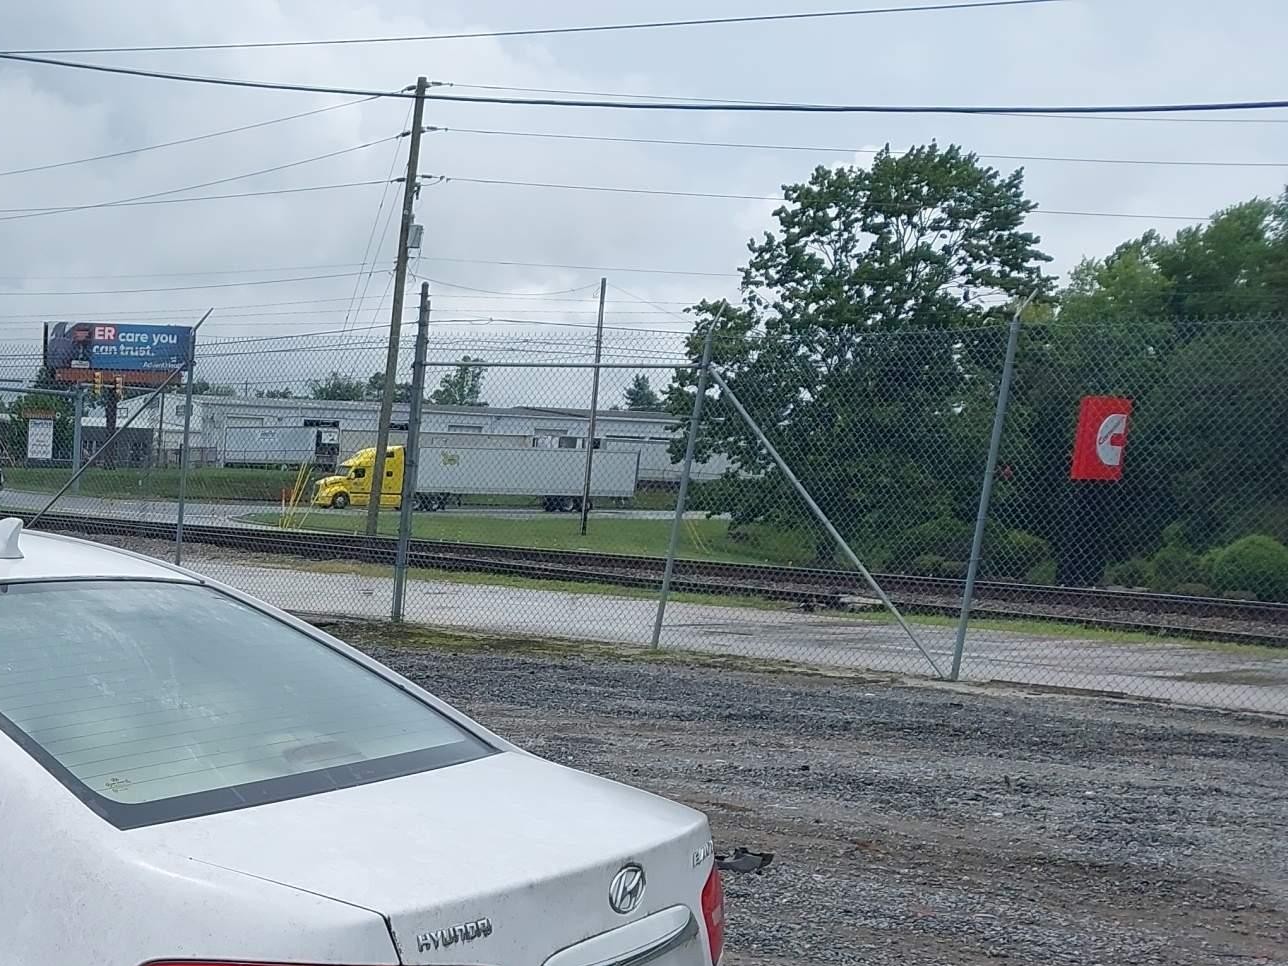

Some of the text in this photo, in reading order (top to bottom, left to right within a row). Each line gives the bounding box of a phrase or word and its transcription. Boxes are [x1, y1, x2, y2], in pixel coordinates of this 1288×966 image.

[94, 326, 178, 346] ER care you
[92, 344, 155, 357] can trust.
